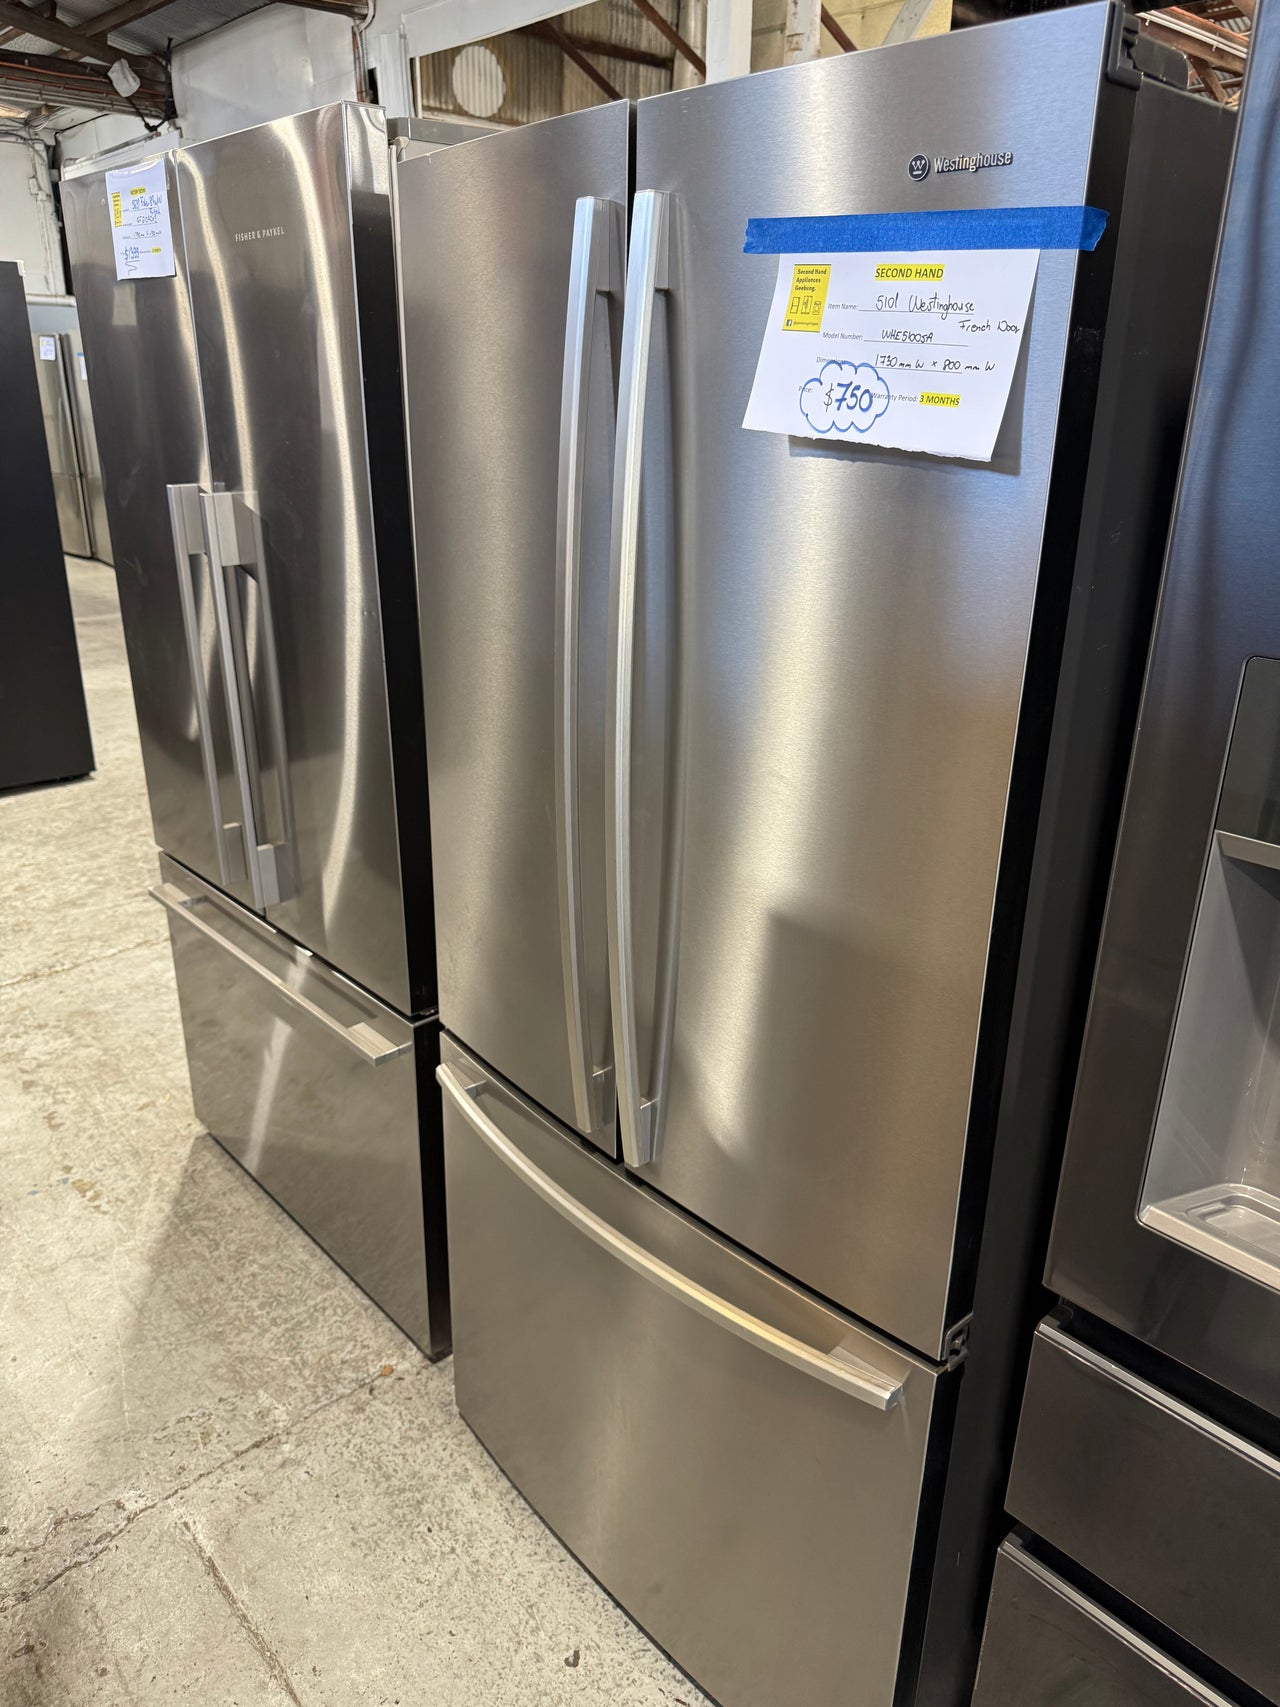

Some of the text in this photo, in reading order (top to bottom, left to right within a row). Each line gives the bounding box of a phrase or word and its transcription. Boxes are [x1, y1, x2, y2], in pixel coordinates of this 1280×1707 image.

[934, 151, 1012, 173] Westinghouse
[235, 226, 284, 242] FISHER & PAYKEL
[875, 268, 944, 279] SECOND HAND
[908, 292, 975, 320] Westinghouse
[958, 319, 991, 333] French
[875, 353, 898, 368] 1730
[942, 359, 961, 371] 800
[898, 394, 918, 402] Period:
[919, 394, 924, 403] 3
[925, 395, 960, 406] MONTHS
